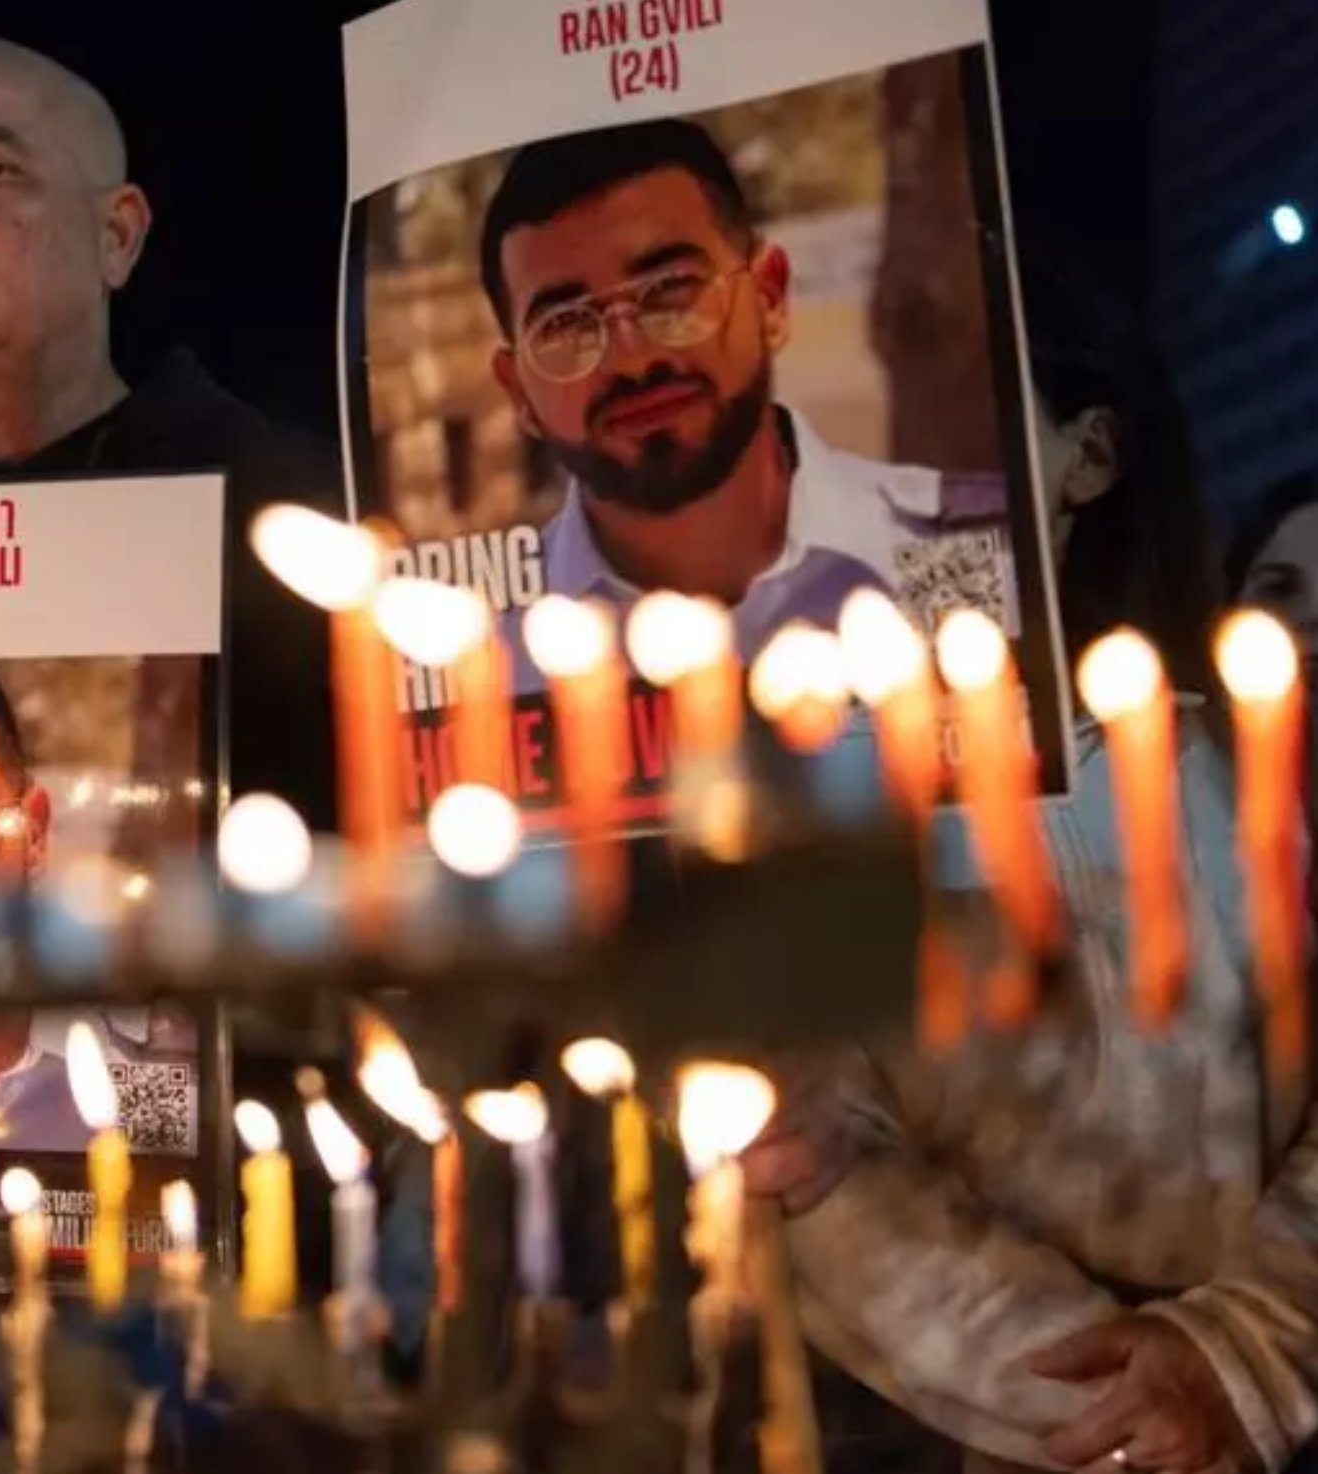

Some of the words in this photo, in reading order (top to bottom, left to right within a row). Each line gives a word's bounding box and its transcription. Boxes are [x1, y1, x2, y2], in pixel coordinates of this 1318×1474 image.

[560, 3, 628, 55] RAN
[638, 0, 723, 40] GVILI
[610, 40, 680, 103] (24)
[40, 1189, 96, 1215] STAGES
